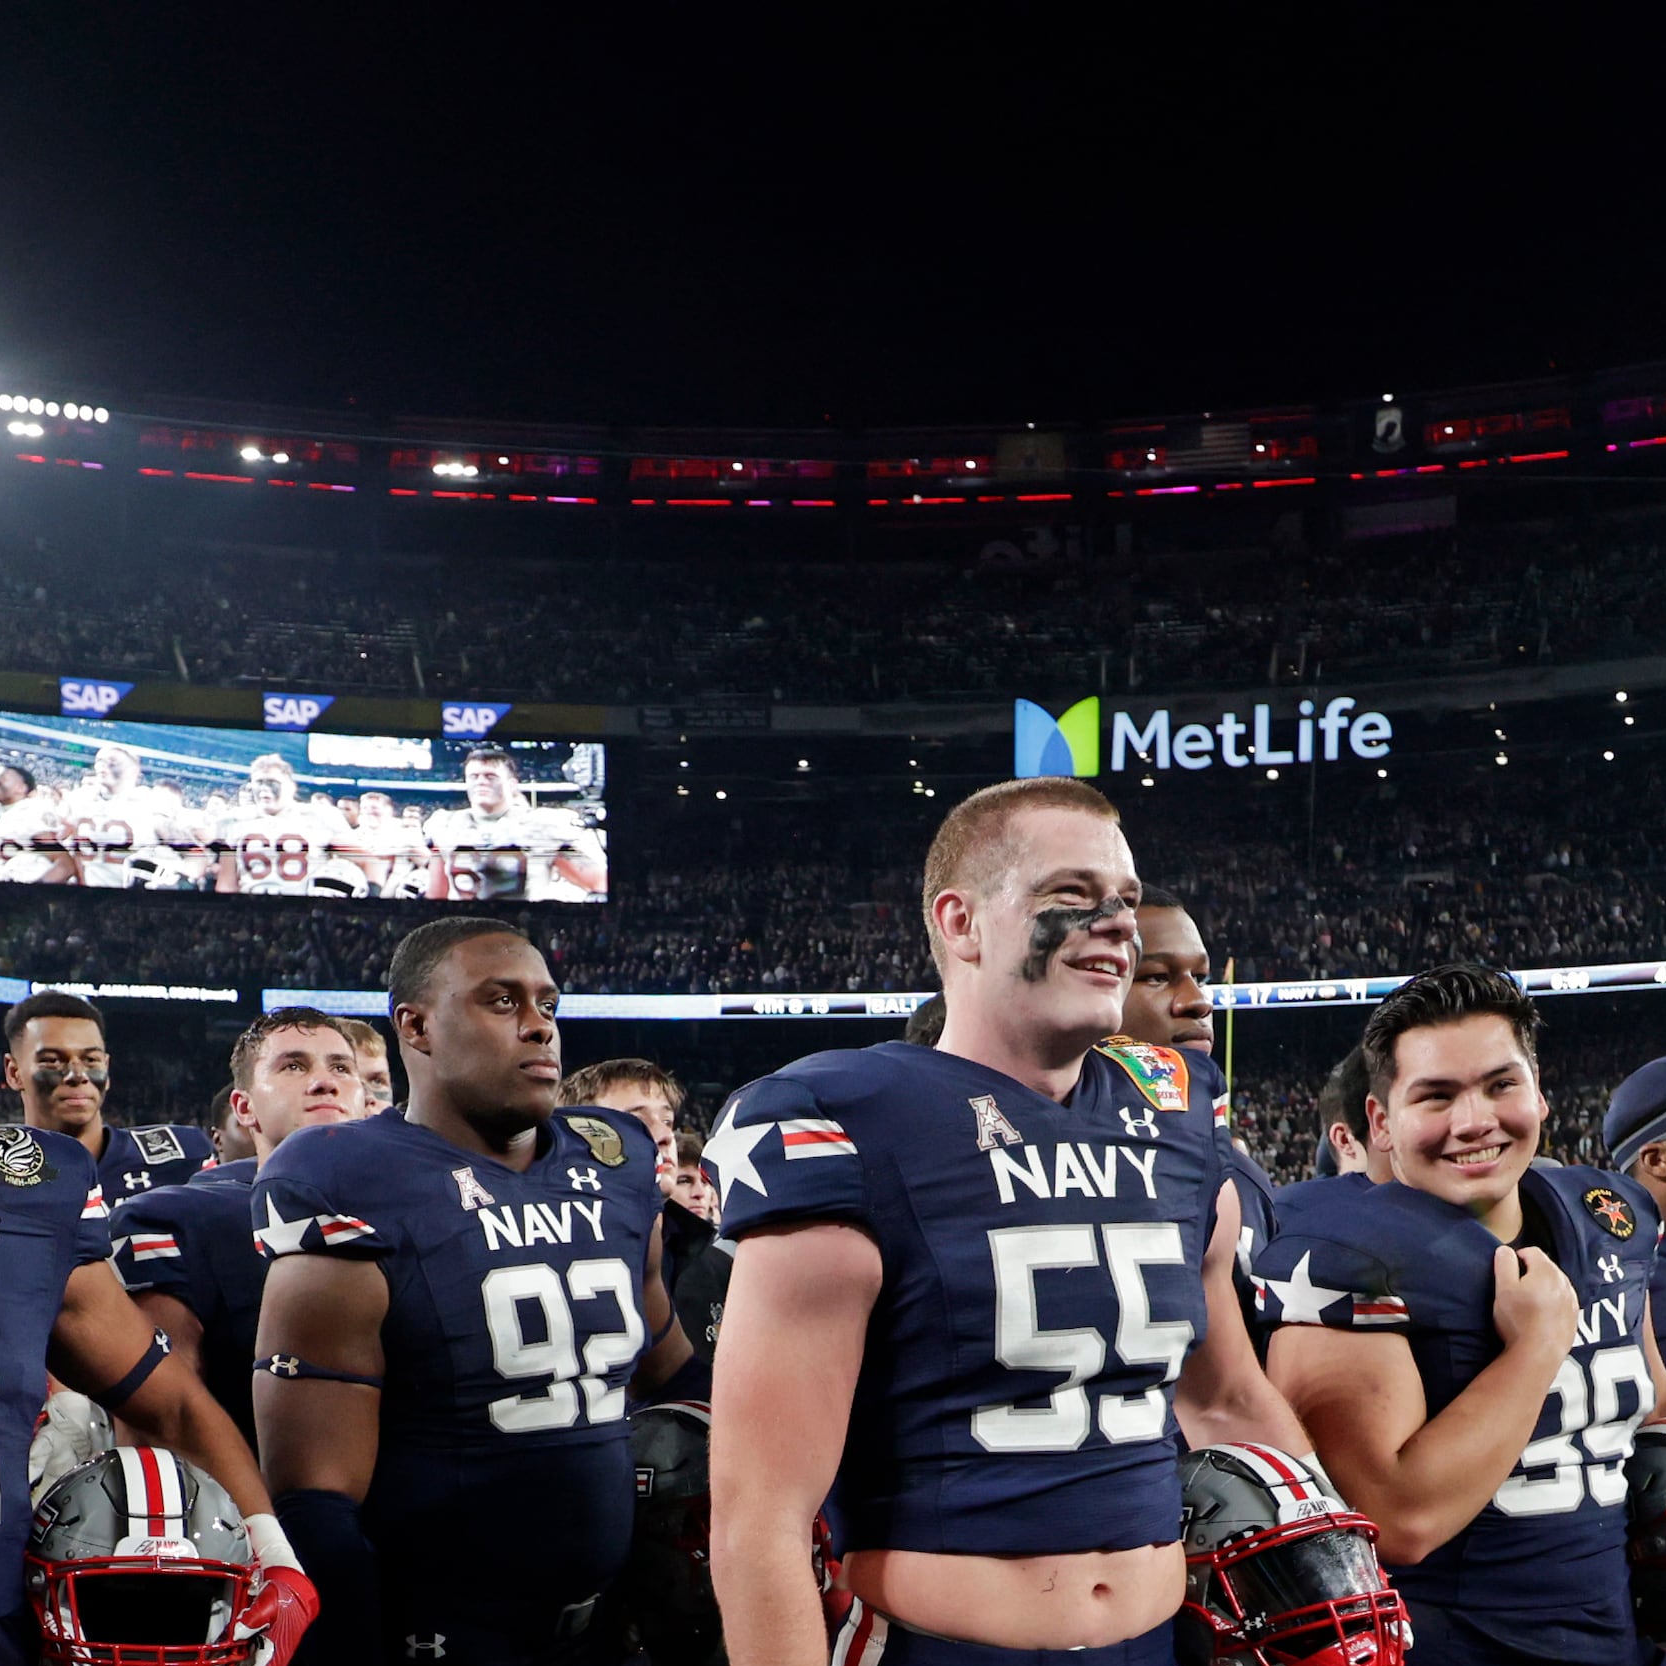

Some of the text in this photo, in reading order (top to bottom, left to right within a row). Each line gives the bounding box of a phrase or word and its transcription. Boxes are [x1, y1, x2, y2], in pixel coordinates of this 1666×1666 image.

[60, 681, 121, 713] SAP
[263, 696, 321, 727] SAP
[442, 705, 499, 734] SAP
[1110, 696, 1394, 772] MetLife
[242, 833, 310, 882] 68
[753, 997, 784, 1014] 4TH
[1277, 987, 1316, 1001] NAVY
[989, 1142, 1159, 1205] NAVY
[478, 1200, 605, 1252] NAVY
[480, 1257, 646, 1434] 92
[970, 1222, 1195, 1453] 55
[1572, 1292, 1630, 1348] VY
[1492, 1344, 1656, 1518] 39
